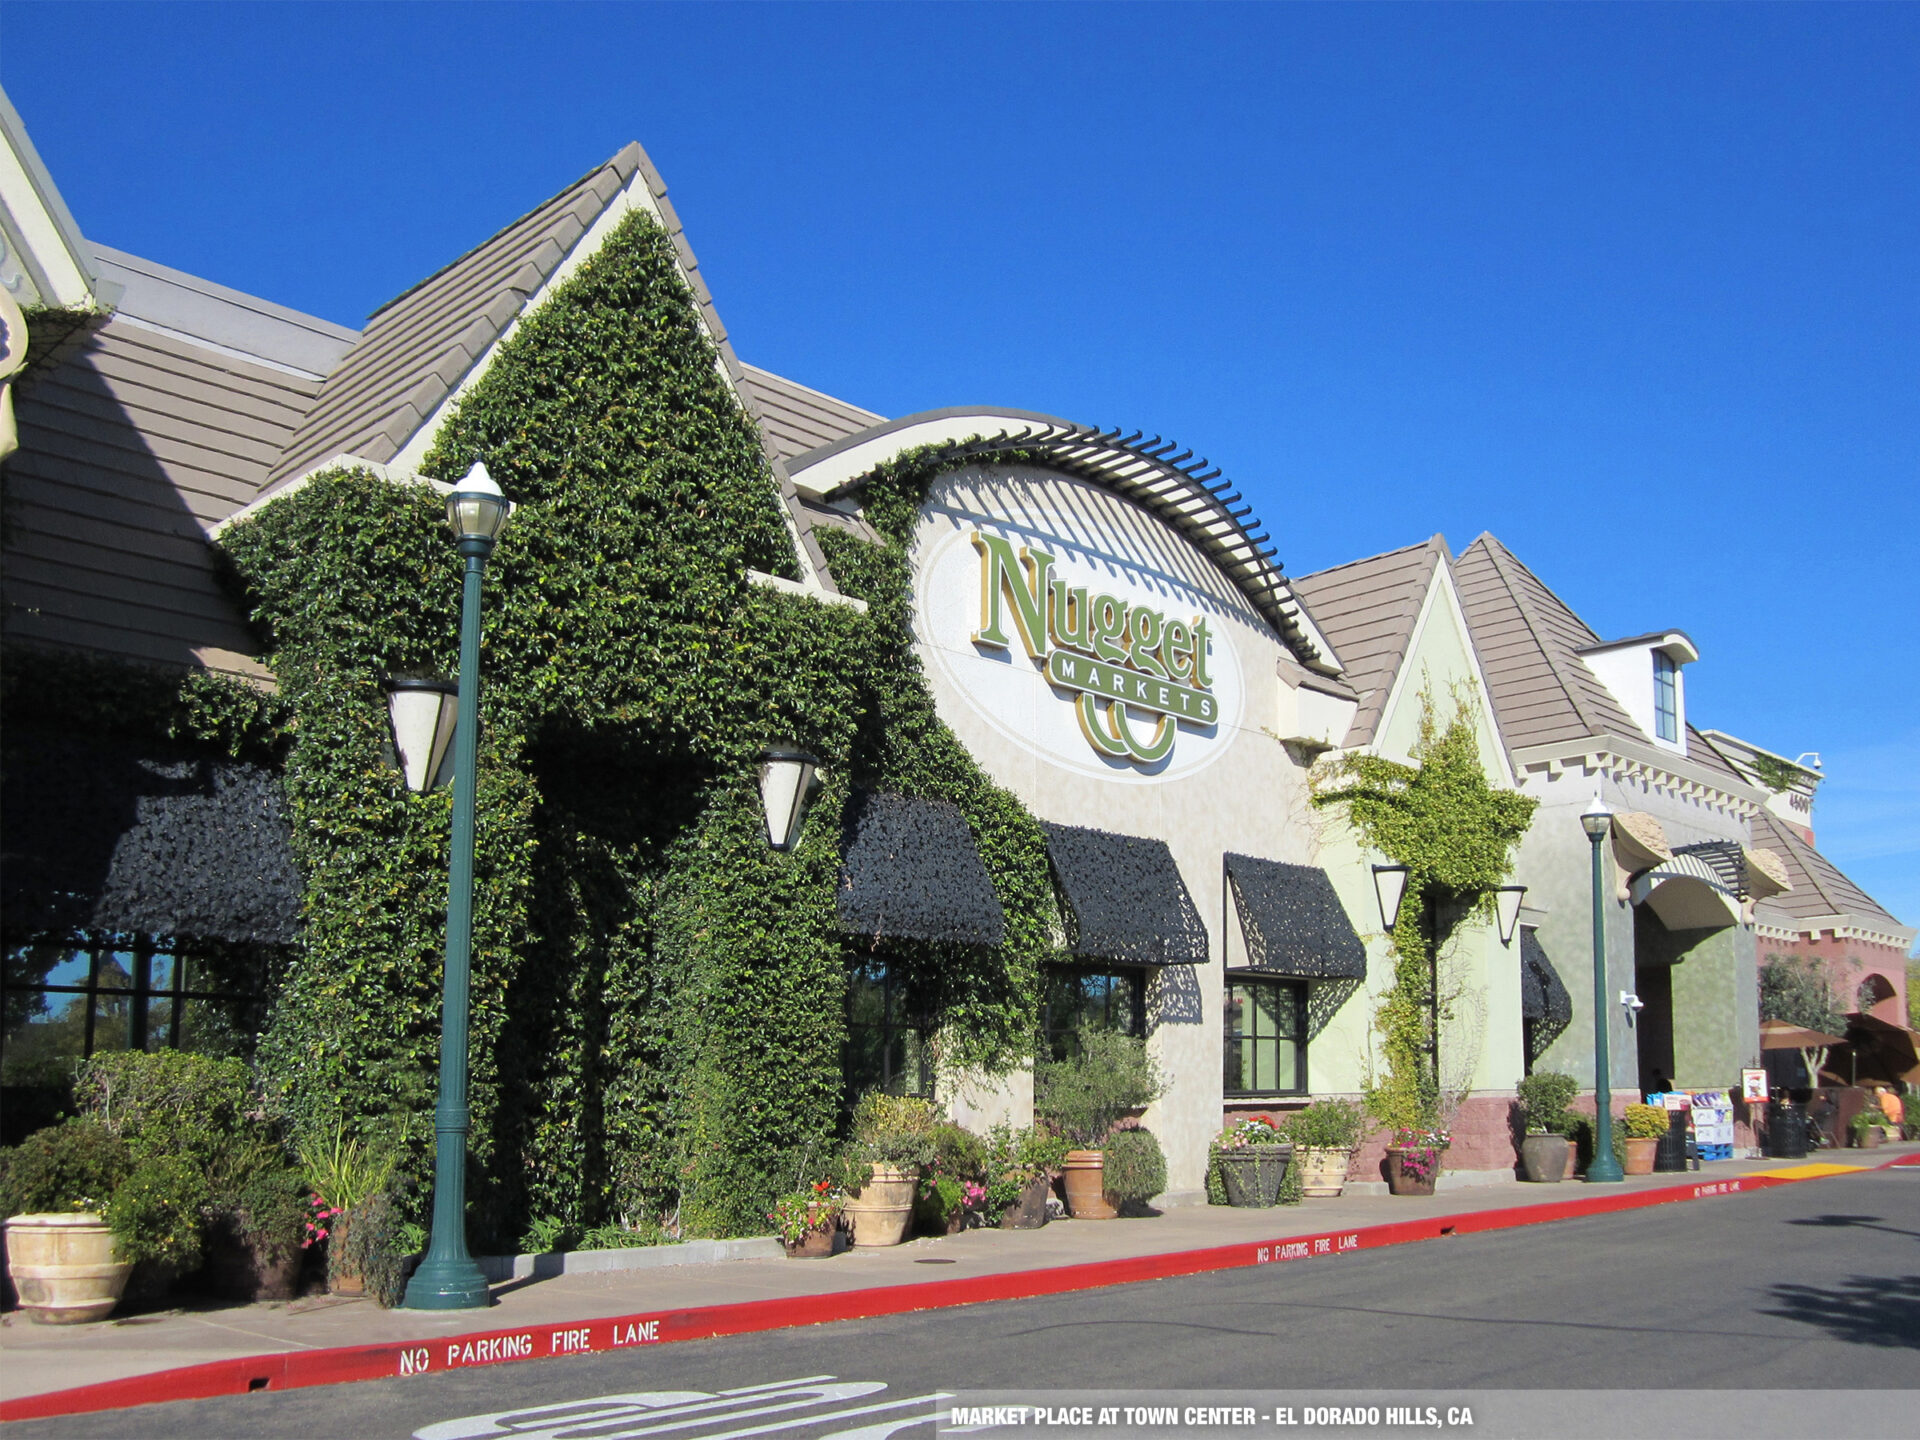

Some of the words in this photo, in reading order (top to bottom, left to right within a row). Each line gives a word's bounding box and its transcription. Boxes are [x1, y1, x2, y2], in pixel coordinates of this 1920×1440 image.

[971, 531, 1213, 688] Nugget
[1061, 659, 1212, 717] MARKETS
[1257, 1247, 1270, 1264] NO
[1275, 1242, 1309, 1260] PARKING
[1314, 1238, 1331, 1253] FIRE
[1338, 1234, 1358, 1249] LANE
[400, 1347, 430, 1375] NO
[447, 1333, 533, 1366] PARKING
[552, 1328, 591, 1353] FIRE
[613, 1320, 660, 1346] LANE
